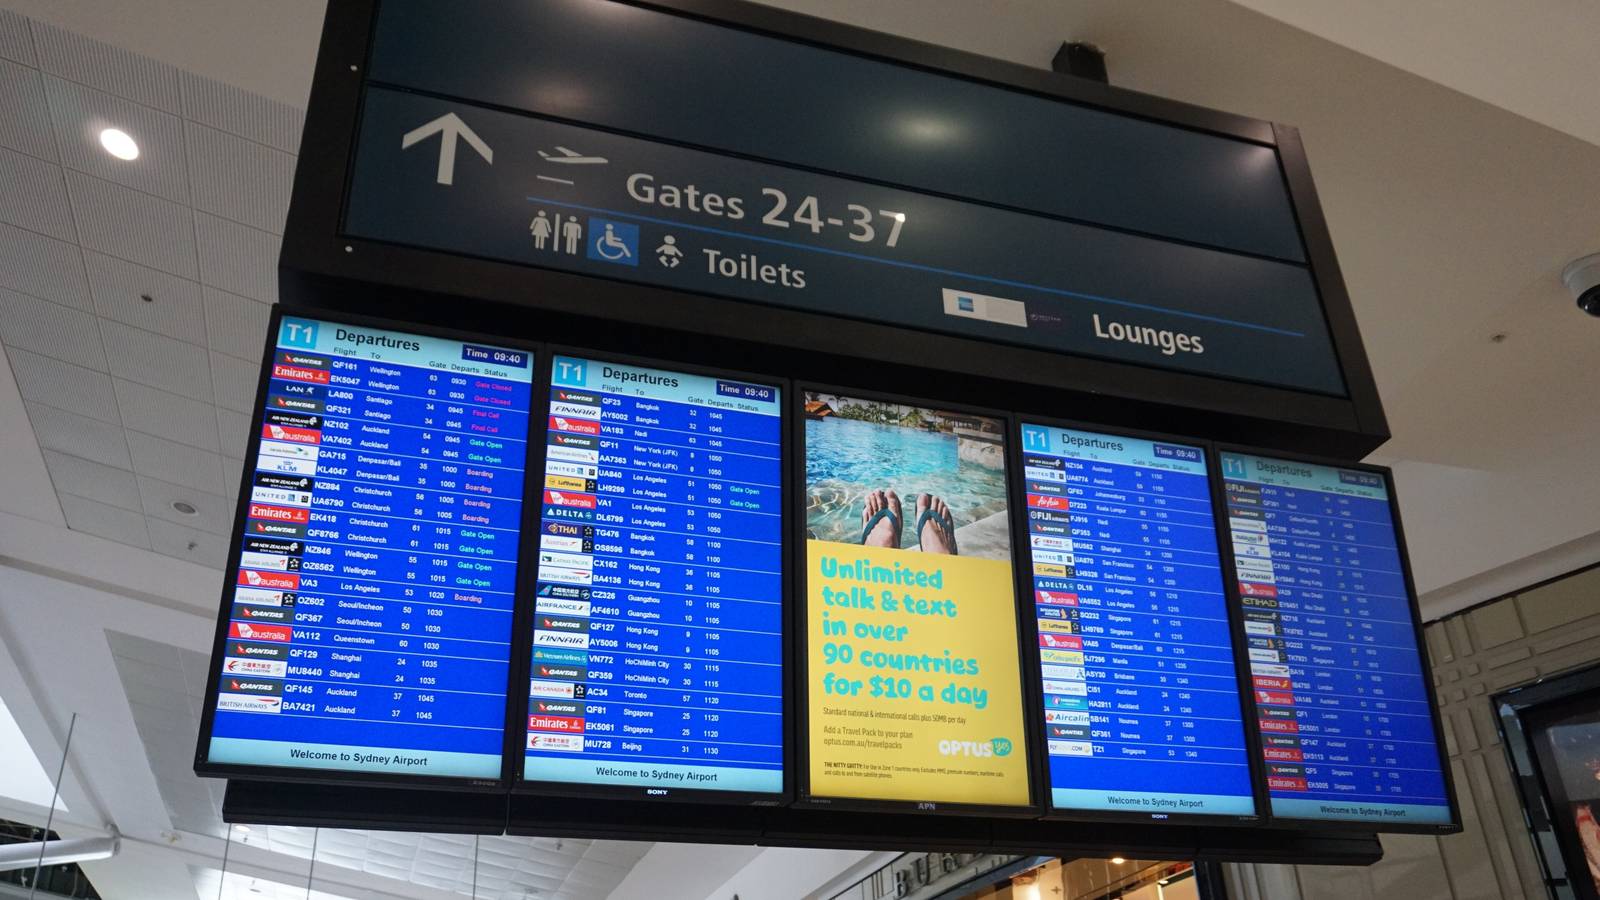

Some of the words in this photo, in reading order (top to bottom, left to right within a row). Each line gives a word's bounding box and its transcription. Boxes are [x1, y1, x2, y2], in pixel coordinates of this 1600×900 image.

[626, 173, 744, 220] Gates
[761, 187, 906, 248] 24-37
[702, 247, 807, 289] Toilets
[287, 323, 312, 344] T1
[335, 329, 420, 352] Departures
[466, 348, 489, 359] Time
[494, 352, 520, 363] 09:40
[1092, 314, 1204, 356] Lounges
[334, 347, 356, 357] Flight
[429, 360, 446, 369] Gate
[451, 363, 480, 374] Departs
[484, 368, 508, 378] Status
[559, 362, 582, 381] T1
[602, 367, 678, 388] Departures
[720, 384, 740, 394] Time
[745, 387, 769, 398] 09:40
[328, 390, 353, 400] LA800
[366, 395, 392, 405] Santiago
[602, 384, 623, 393] Flight
[688, 396, 704, 404] Gate
[708, 399, 733, 409] Departs
[738, 403, 758, 411] Status
[1026, 430, 1046, 448] T1
[1062, 433, 1123, 451] Departures
[1156, 447, 1173, 456] Time
[1176, 450, 1196, 459] 09:40
[1224, 458, 1242, 474] T1
[1256, 461, 1312, 477] Departures
[251, 506, 291, 519] Emirates
[310, 513, 336, 522] EK418
[349, 518, 388, 528] Christchurch
[461, 530, 476, 538] Gate
[478, 532, 494, 540] Open
[557, 509, 583, 518] DELTA
[559, 526, 577, 534] THAI
[820, 557, 943, 589] Unlimited
[261, 578, 293, 588] australia
[300, 578, 317, 587] VA3
[354, 584, 380, 593] Angeles
[455, 593, 482, 604] Boarding
[822, 586, 874, 610] talk
[881, 591, 899, 612] &
[904, 594, 957, 617] text
[1243, 599, 1277, 607] ETIHAD
[251, 610, 284, 618] QANTAS
[295, 613, 323, 623] QF367
[337, 617, 382, 628] Seoul/Incheon
[425, 624, 441, 633] 1030
[823, 612, 847, 636] in
[854, 623, 908, 642] over
[540, 636, 584, 644] FINNAIR
[626, 642, 641, 650] Hong
[643, 644, 658, 652] Kong
[705, 648, 719, 656] 1105
[290, 648, 318, 658] QF129
[332, 653, 362, 663] Shanghai
[397, 658, 406, 666] 24
[421, 660, 437, 668] 1035
[823, 643, 853, 665] 90
[860, 650, 979, 675] countries
[285, 684, 312, 694] QF145
[327, 688, 357, 697] Auckland
[394, 692, 402, 700] 37
[418, 694, 434, 702] 1045
[587, 688, 608, 696] AC34
[625, 691, 647, 699] Toronto
[823, 673, 863, 696] for
[870, 675, 911, 699] $10
[918, 684, 934, 701] a
[941, 683, 988, 709] day
[220, 700, 242, 708] BRITISH
[283, 703, 315, 712] BA7421
[324, 705, 355, 715] Auckland
[416, 711, 432, 719] 1045
[547, 704, 576, 712] QANTAS
[586, 706, 606, 714] QF81
[624, 709, 653, 718] Singapore
[823, 707, 847, 716] Standard
[848, 709, 869, 718] national
[875, 711, 907, 721] international
[908, 713, 920, 721] calls
[921, 714, 932, 722] plus
[957, 716, 966, 725] day
[1055, 714, 1089, 722] Aircalin
[530, 717, 568, 729] Emirates
[623, 725, 653, 734] Singapore
[824, 725, 836, 734] Add
[843, 727, 860, 736] Travel
[862, 728, 876, 737] Pack
[900, 731, 913, 739] plan
[824, 738, 902, 749] optus.com.au/travelpacks
[939, 739, 992, 757] OPTUS
[290, 748, 338, 761] Welcome
[340, 751, 352, 762] to
[353, 752, 390, 765] Sydney
[393, 754, 427, 766] Airport
[596, 767, 637, 777] Welcome
[641, 770, 649, 778] to
[652, 770, 684, 781] Sydney
[687, 772, 717, 782] Airport
[918, 802, 935, 811] APN
[1108, 796, 1141, 805] Welcome
[1143, 798, 1150, 806] to
[1152, 798, 1177, 808] Sydney
[1179, 799, 1203, 808] Airport
[1321, 806, 1349, 815] Welcome
[1351, 807, 1358, 815] to
[1359, 807, 1382, 817] Sydney
[1384, 808, 1406, 817] Airport
